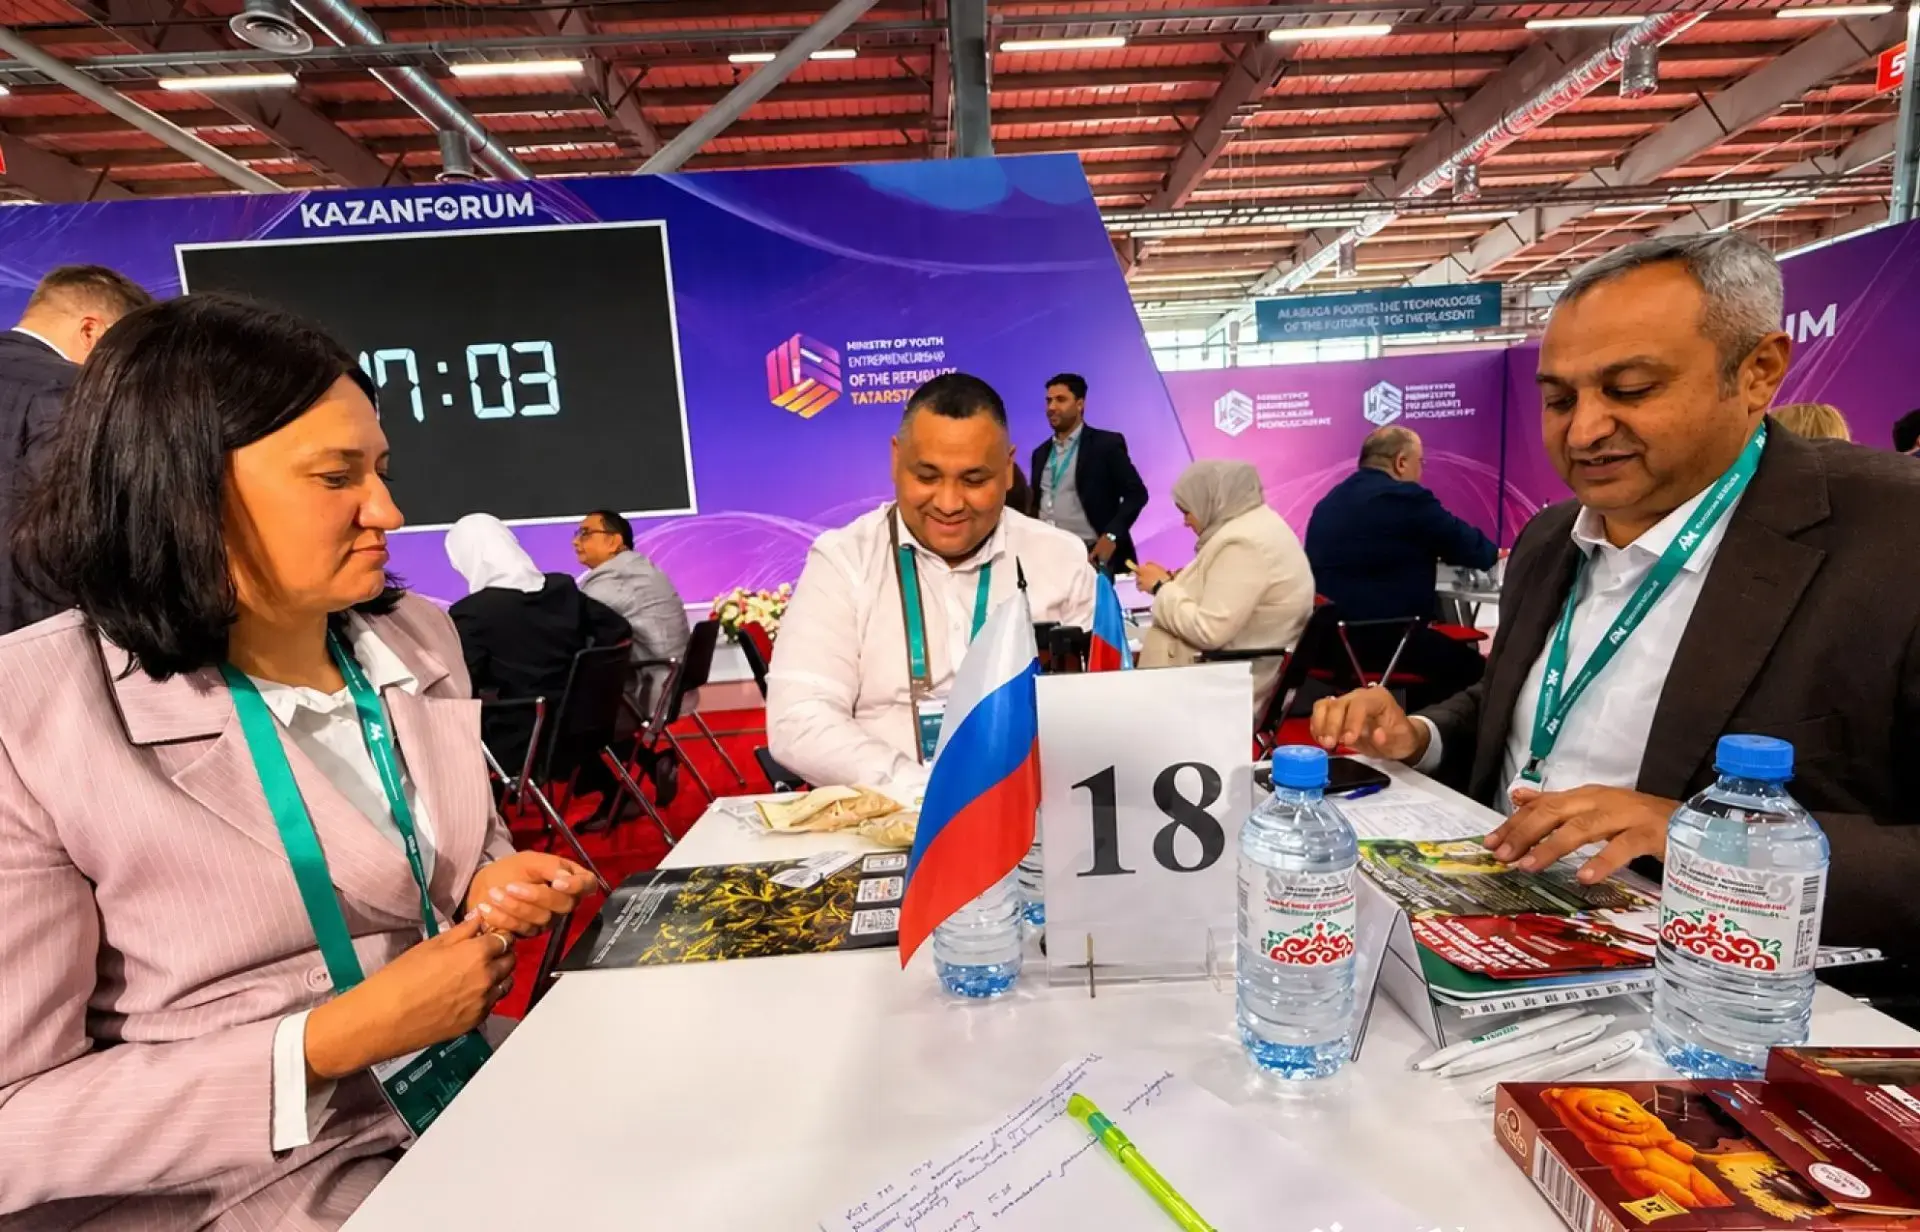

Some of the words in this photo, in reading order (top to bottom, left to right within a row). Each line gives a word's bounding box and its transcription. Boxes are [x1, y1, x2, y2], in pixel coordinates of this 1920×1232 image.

[301, 191, 535, 228] KAZANFORUM
[894, 339, 907, 348] OF
[909, 336, 943, 347] YOUTH
[849, 374, 867, 387] OF
[867, 371, 891, 386] THE
[1071, 761, 1225, 878] 18
